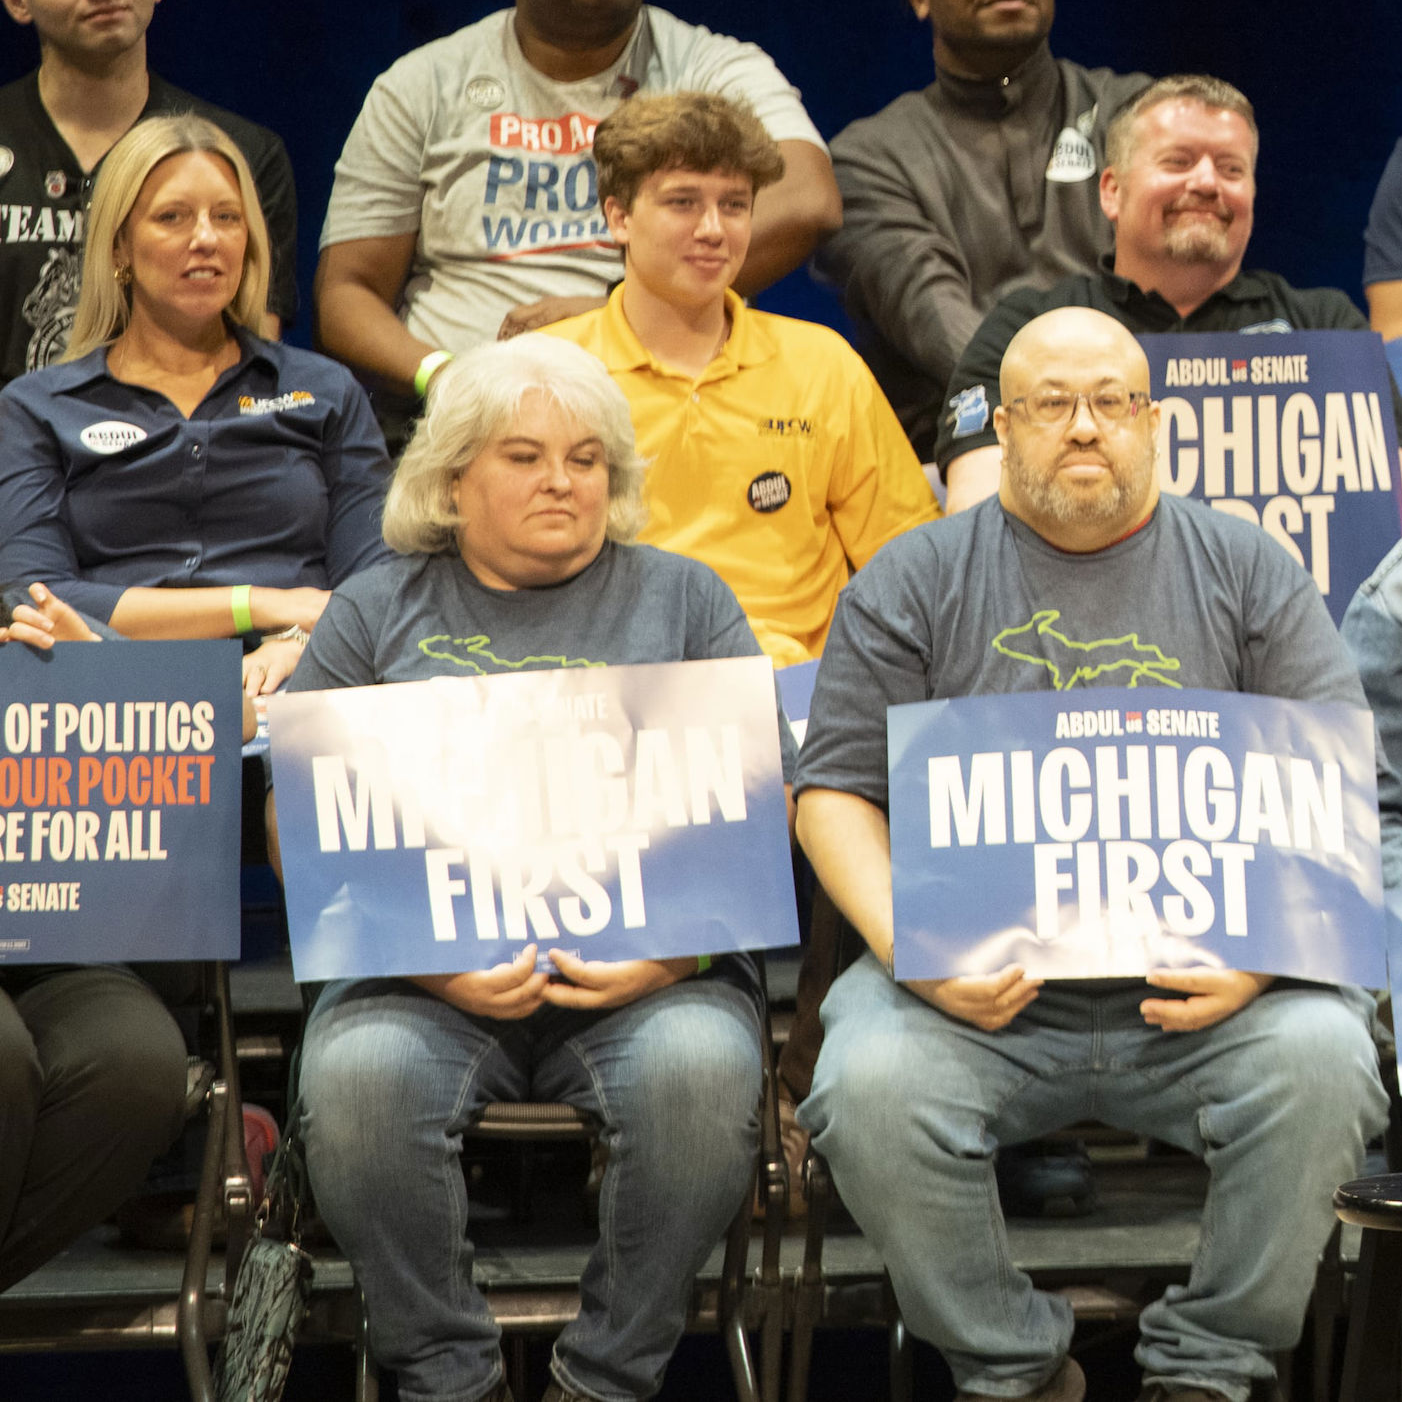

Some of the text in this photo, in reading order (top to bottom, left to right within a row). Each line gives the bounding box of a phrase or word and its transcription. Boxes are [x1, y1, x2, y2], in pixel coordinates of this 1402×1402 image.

[500, 115, 563, 151] PRO
[484, 155, 600, 214] PRO
[1165, 357, 1231, 387] ABDUL
[1250, 354, 1309, 385] SENATE
[4, 702, 49, 754] OF
[54, 700, 216, 753] POLITICS
[1055, 710, 1125, 740] ABDUL
[1146, 708, 1221, 740] SENATE
[78, 755, 216, 807] POCKET
[927, 745, 1346, 855] MICHIGAN
[30, 810, 101, 862] FOR
[104, 809, 168, 862] ALL
[7, 882, 81, 912] SENATE
[425, 833, 650, 941] FIRST
[1033, 839, 1256, 941] FIRST
